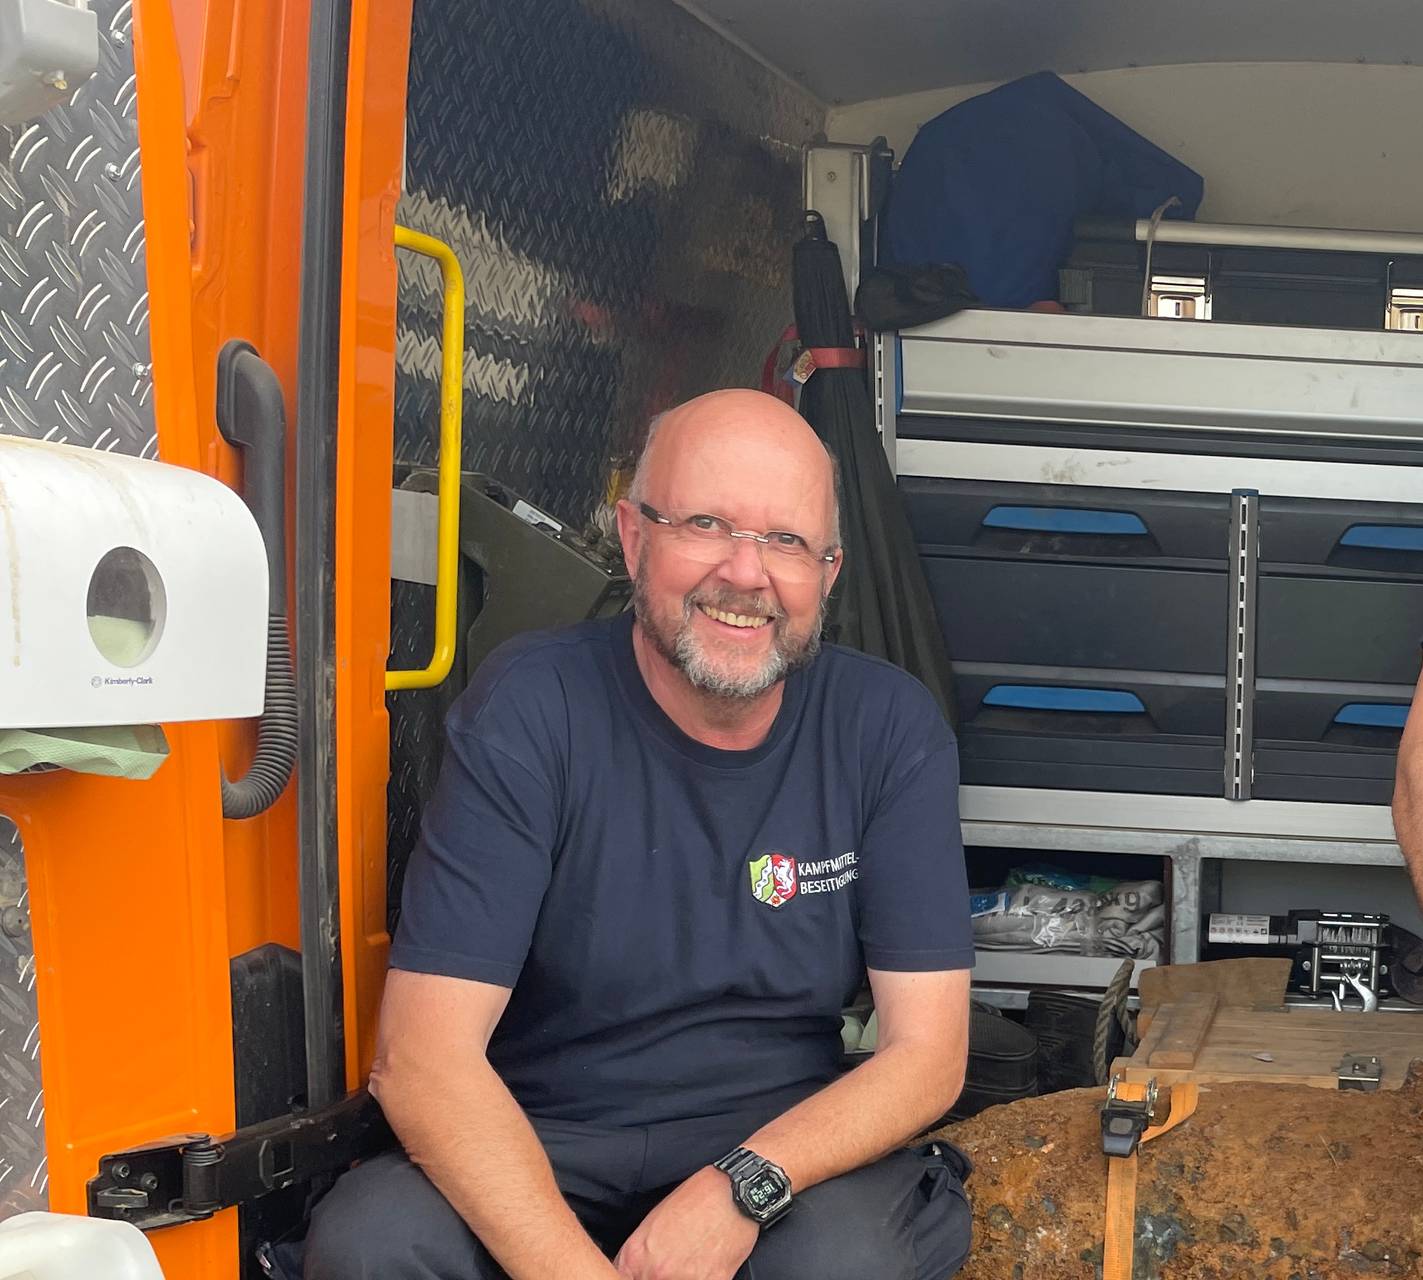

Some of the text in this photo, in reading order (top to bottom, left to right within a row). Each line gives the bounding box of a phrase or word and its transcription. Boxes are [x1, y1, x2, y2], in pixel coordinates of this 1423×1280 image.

[104, 676, 153, 687] Kimberly-Clark
[797, 851, 860, 877] KAMPFMITTEL-
[799, 868, 859, 895] BESEITIGUNG
[752, 1183, 776, 1203] 16:24
